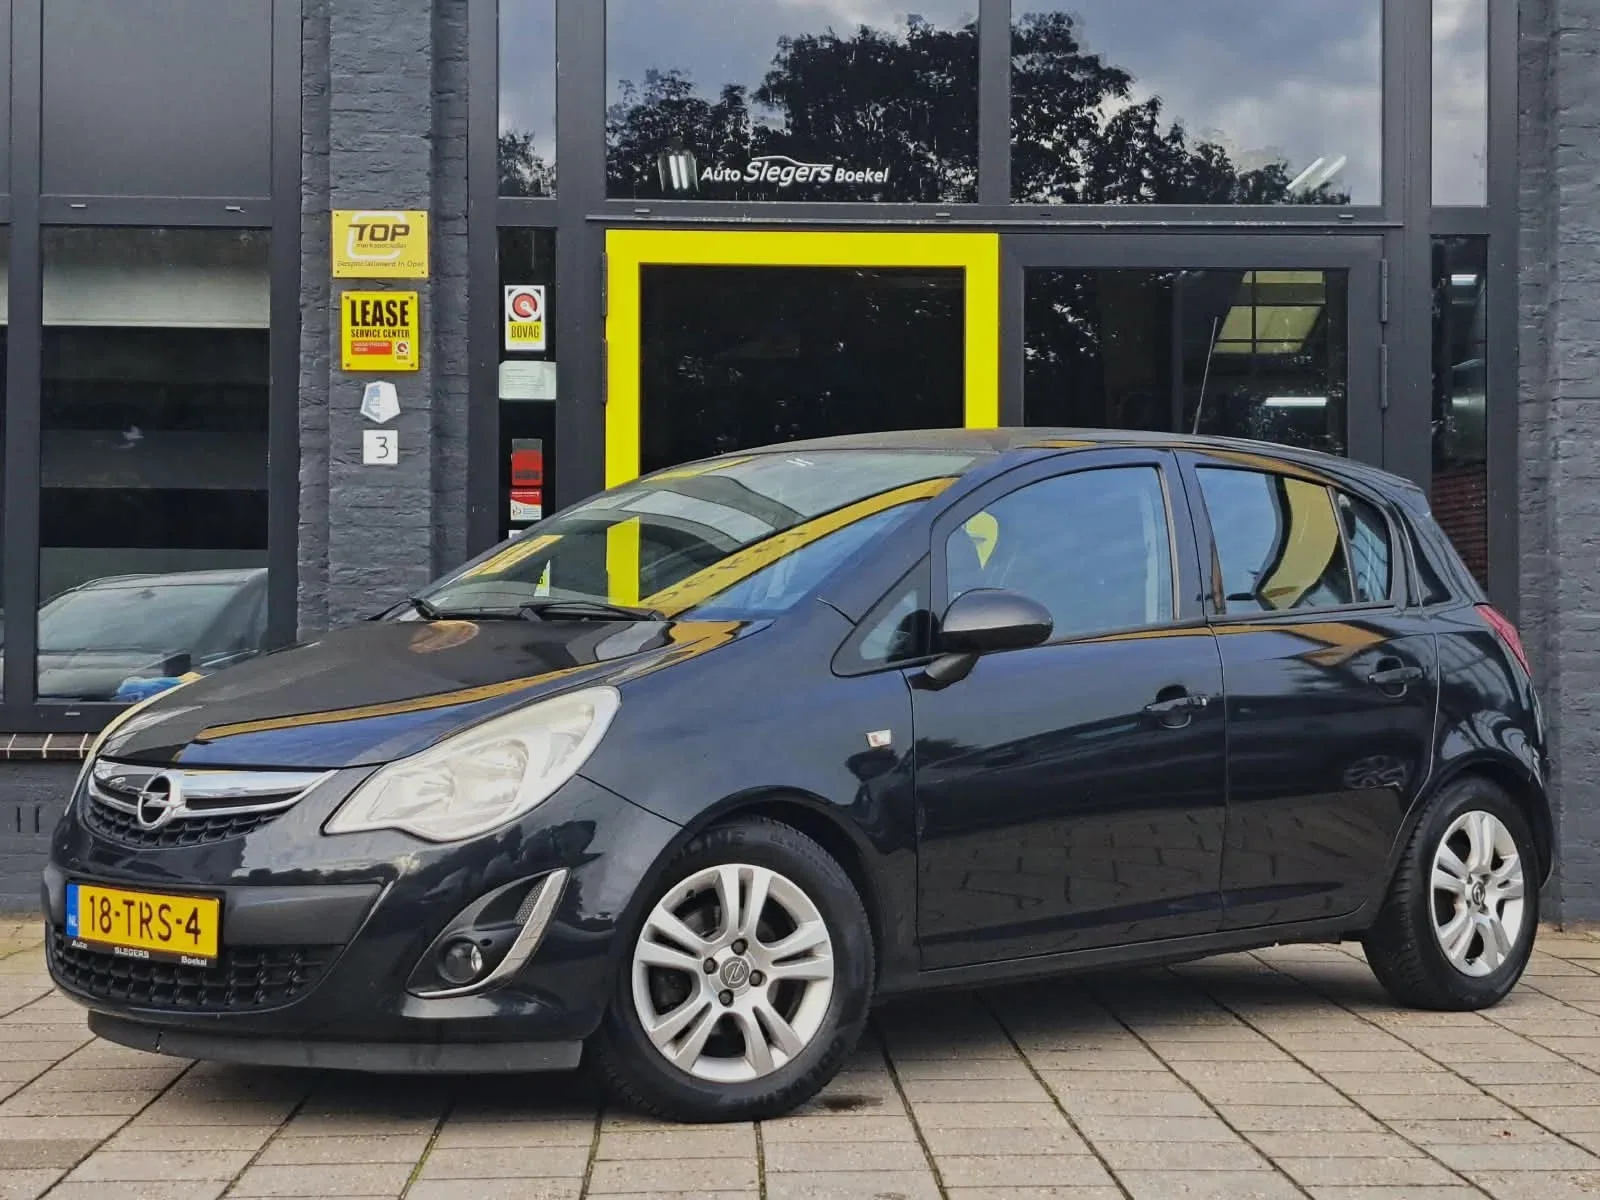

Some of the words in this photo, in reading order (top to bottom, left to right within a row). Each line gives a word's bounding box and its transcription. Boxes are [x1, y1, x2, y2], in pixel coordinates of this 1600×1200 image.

[700, 166, 741, 182] Auto
[743, 160, 834, 187] Slegers
[834, 167, 889, 183] Boekel
[348, 224, 410, 241] TOP
[351, 299, 410, 327] LEASE
[351, 329, 381, 338] SERVICE
[383, 329, 410, 338] CENTER
[511, 325, 540, 338] BOVAG
[375, 436, 389, 458] 3
[89, 895, 202, 945] 18-TRS-4
